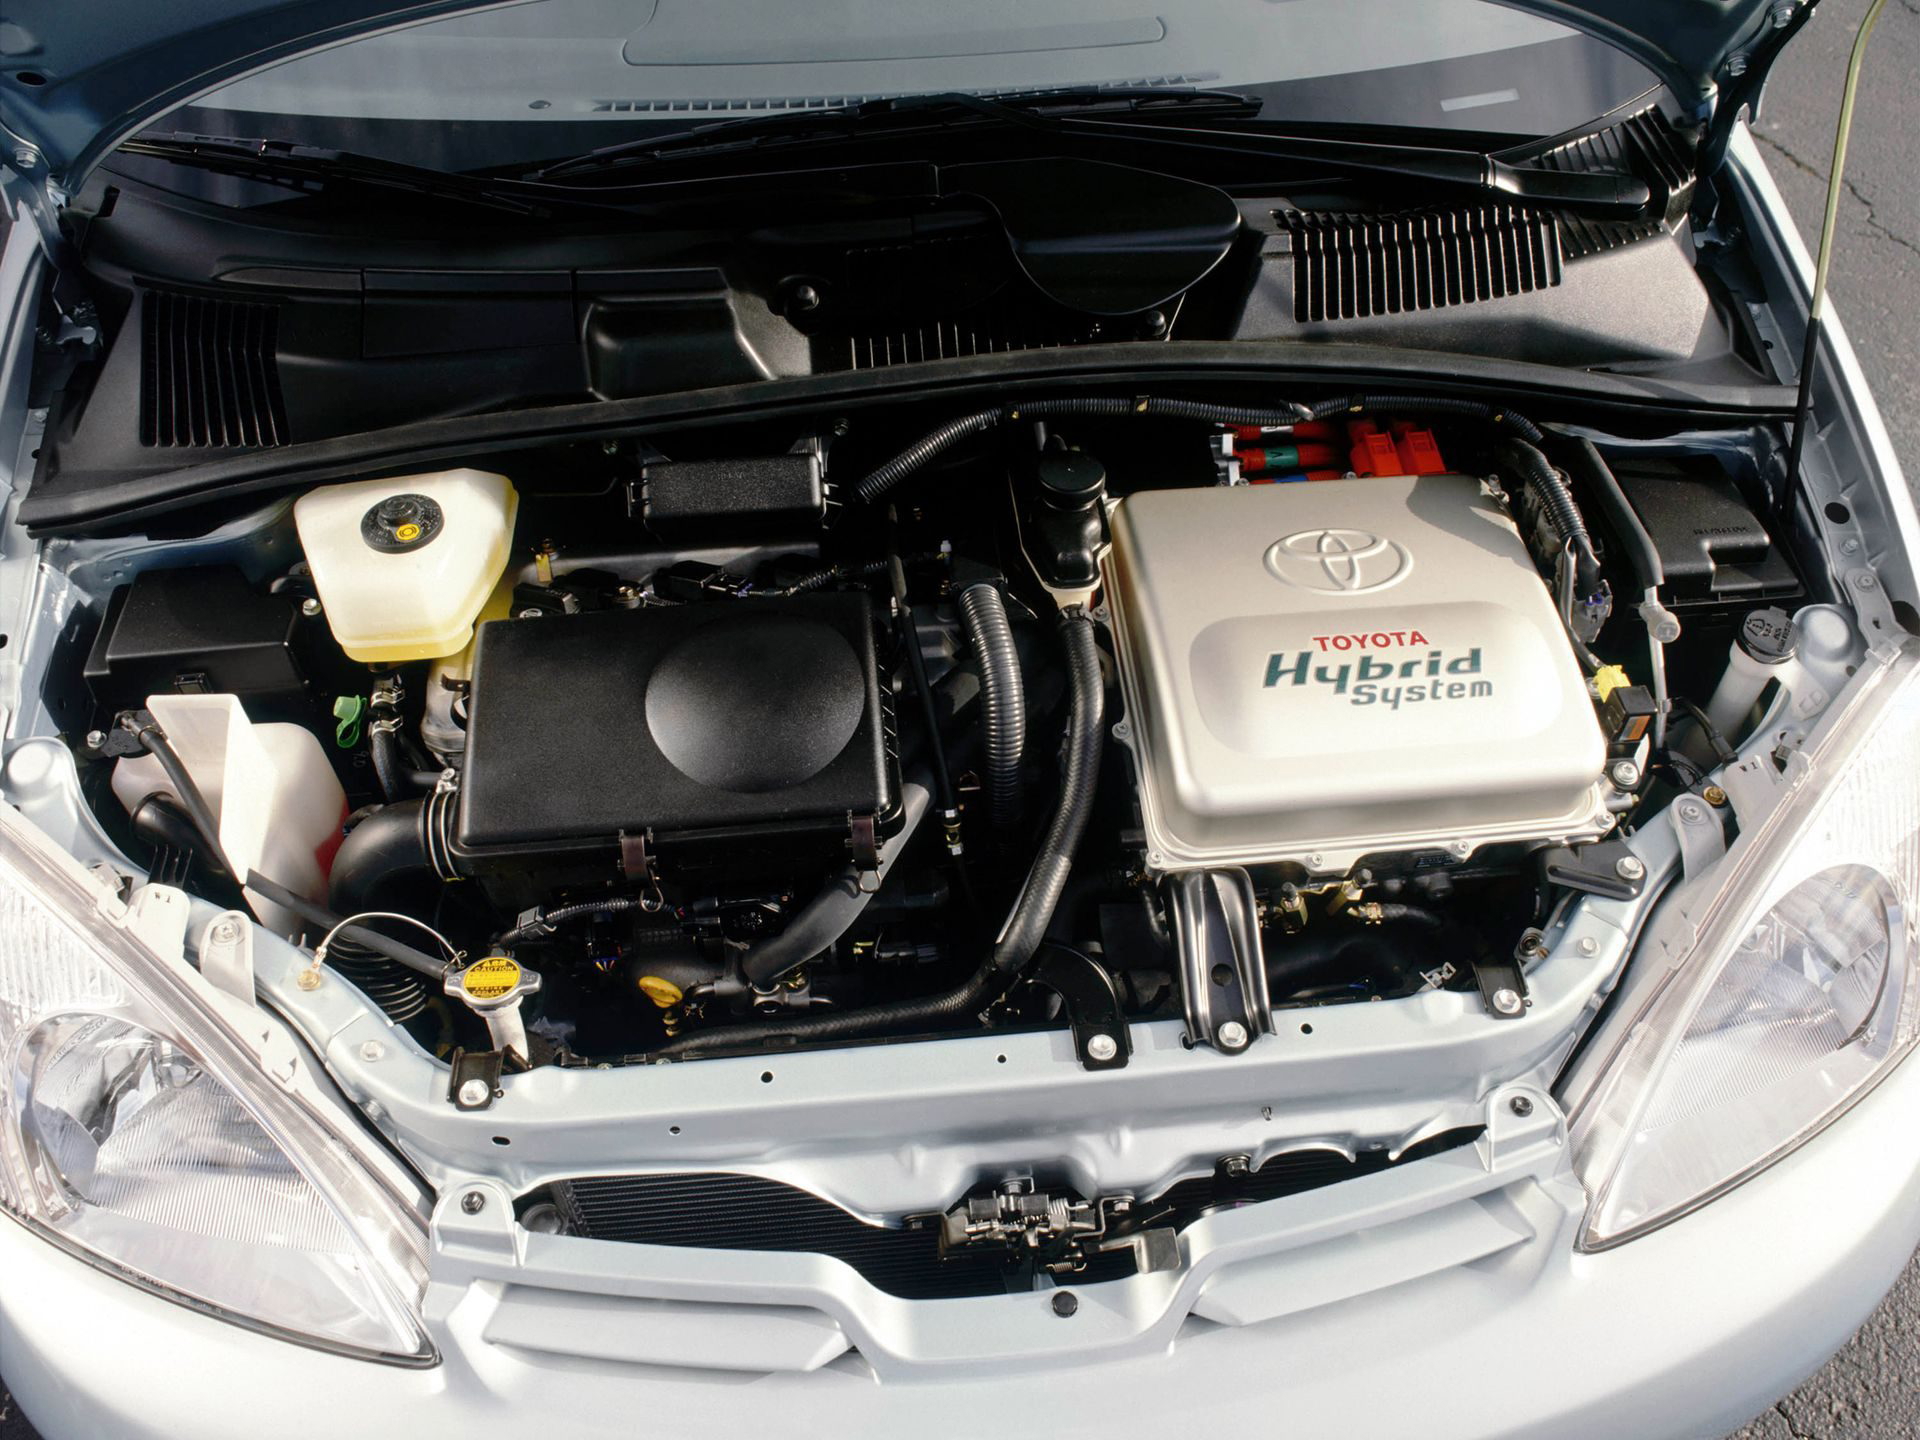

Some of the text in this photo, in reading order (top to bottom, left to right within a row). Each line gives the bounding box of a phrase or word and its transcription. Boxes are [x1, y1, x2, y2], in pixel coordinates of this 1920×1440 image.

[1312, 631, 1429, 652] TOYOTA
[1262, 648, 1482, 695] Hybrid
[1350, 679, 1494, 710] System
